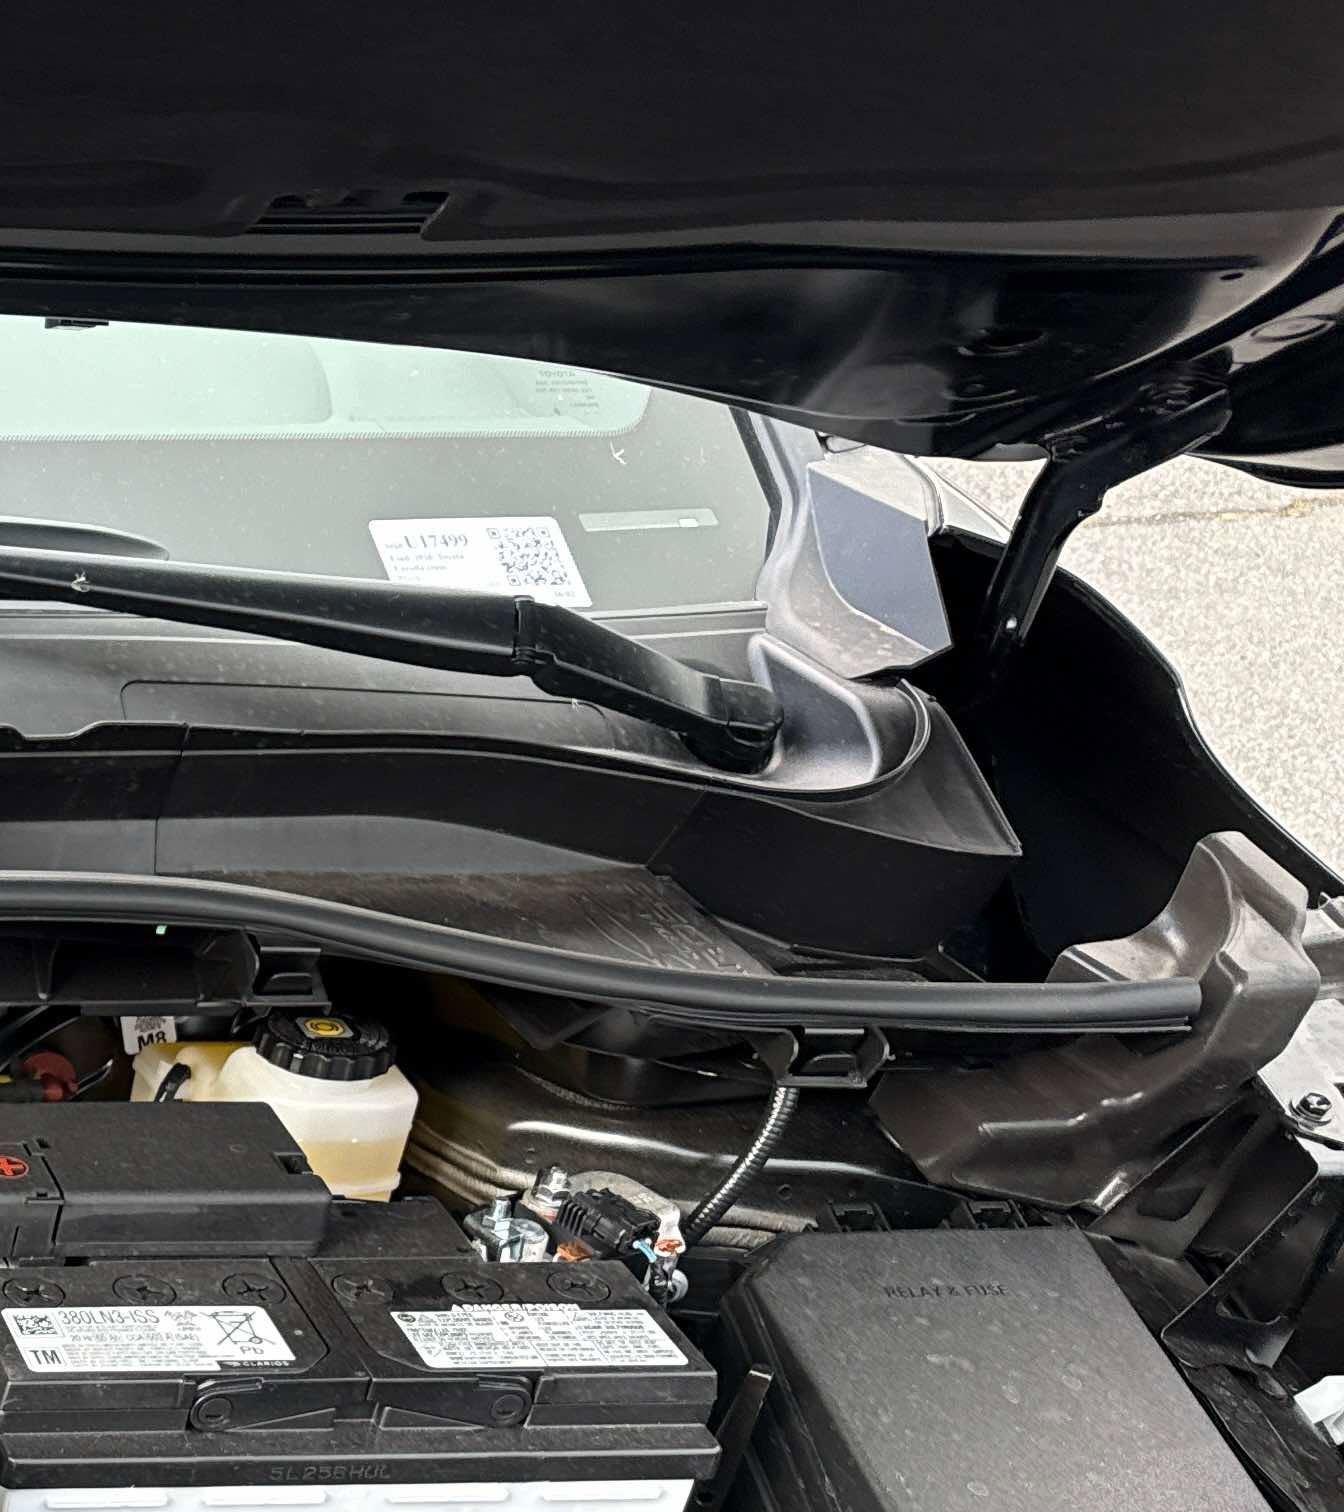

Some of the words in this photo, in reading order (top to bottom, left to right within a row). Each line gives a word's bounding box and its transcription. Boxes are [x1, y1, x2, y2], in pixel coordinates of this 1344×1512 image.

[58, 1310, 160, 1325] 380LN3-ISS
[30, 1349, 62, 1366] TM
[240, 1345, 265, 1355] Pb
